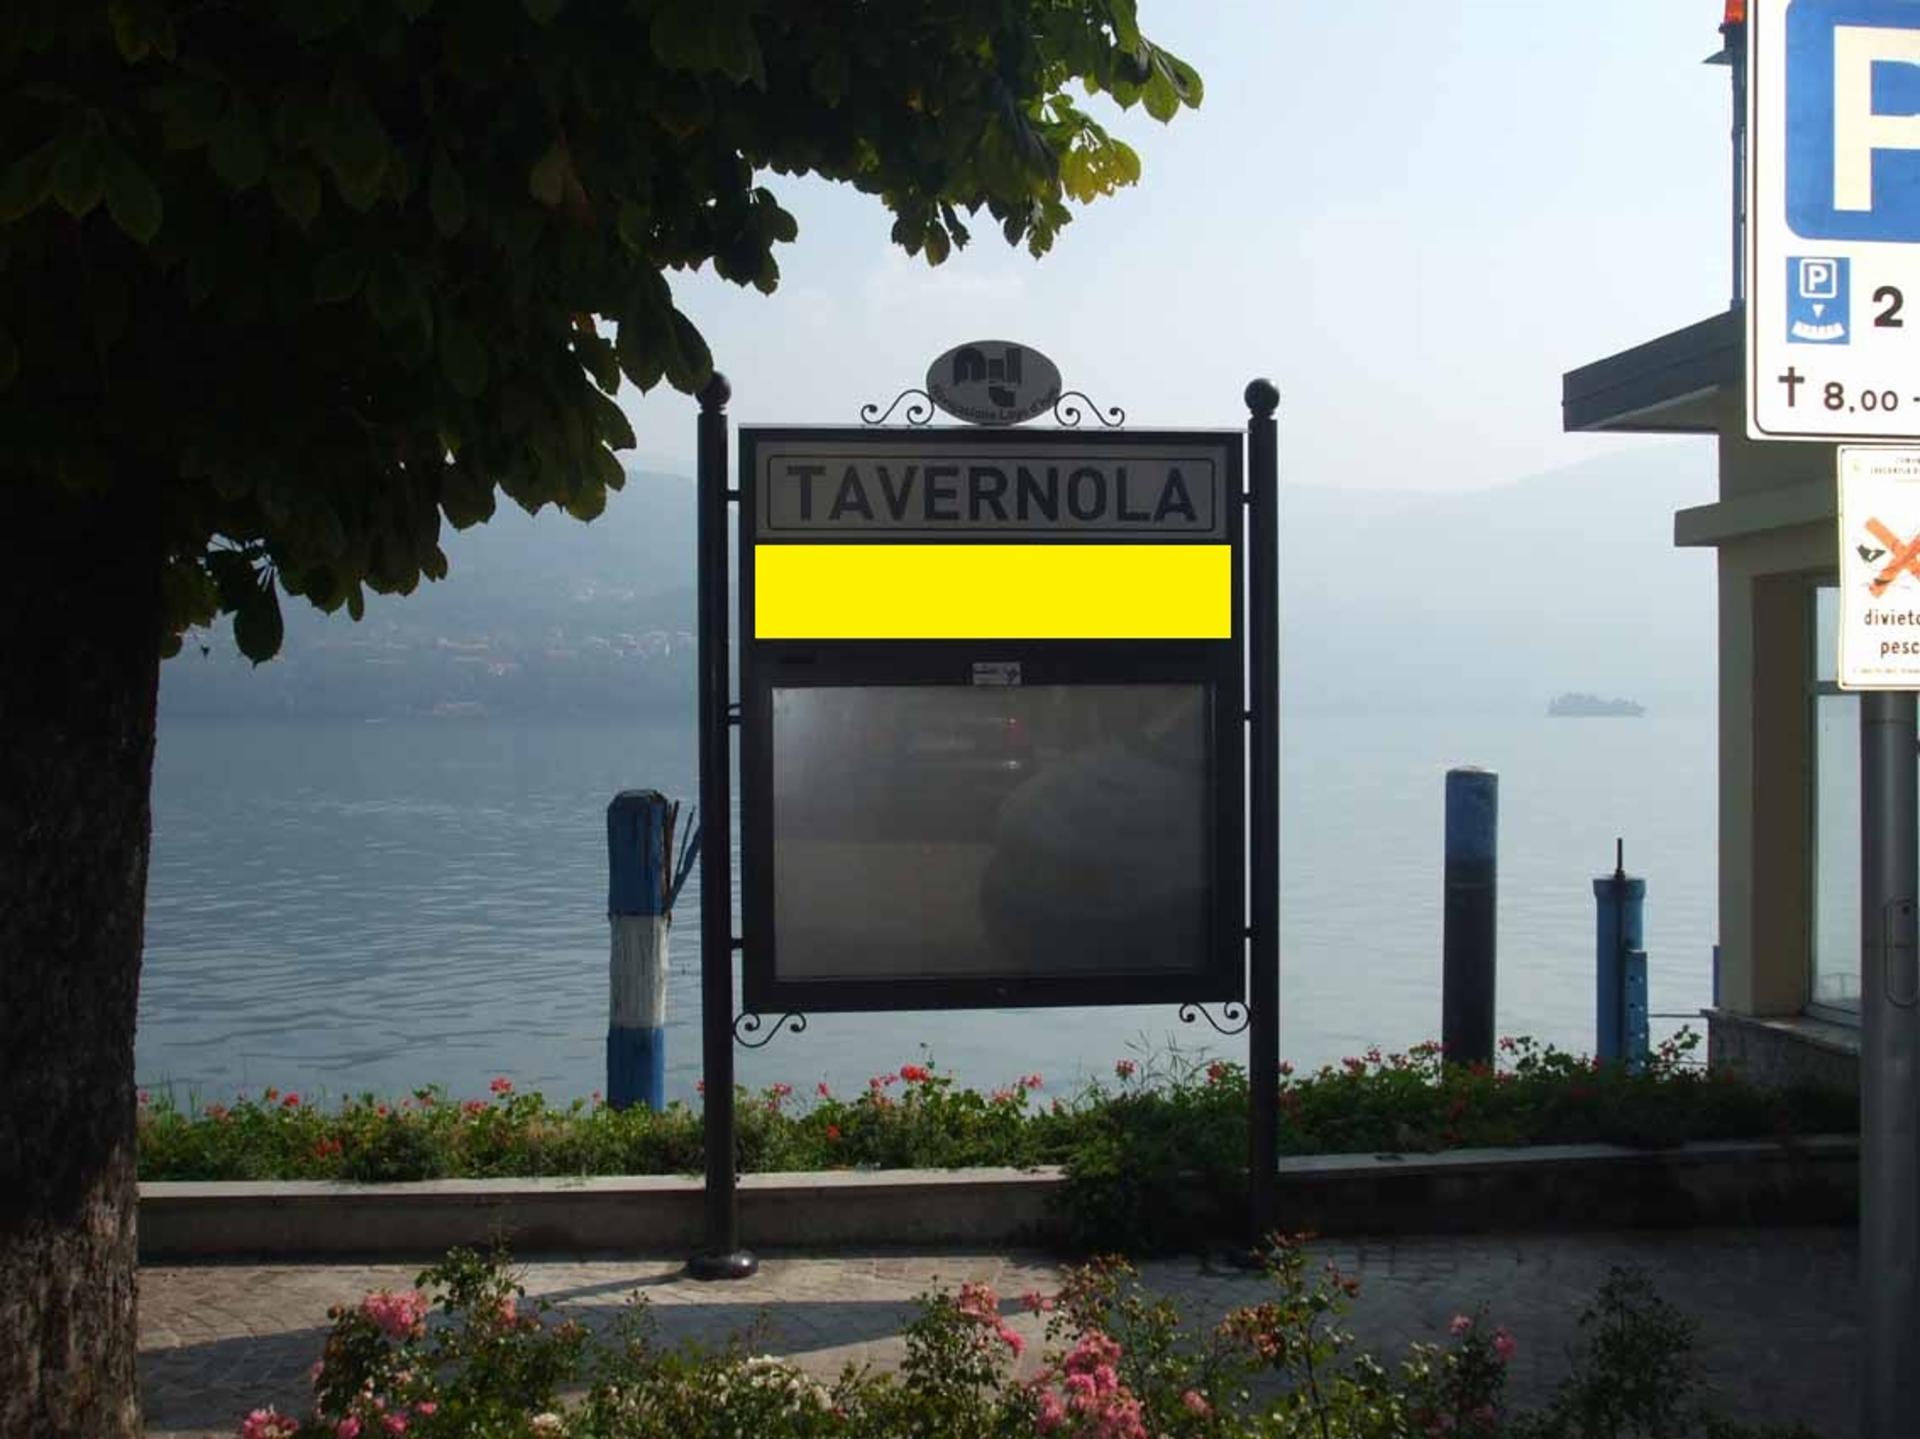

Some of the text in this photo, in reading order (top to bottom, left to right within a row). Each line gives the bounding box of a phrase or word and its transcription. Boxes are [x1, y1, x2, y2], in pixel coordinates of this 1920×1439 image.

[1808, 265, 1829, 291] P
[1872, 285, 1904, 328] 2
[786, 465, 1197, 523] TAVERNOLA
